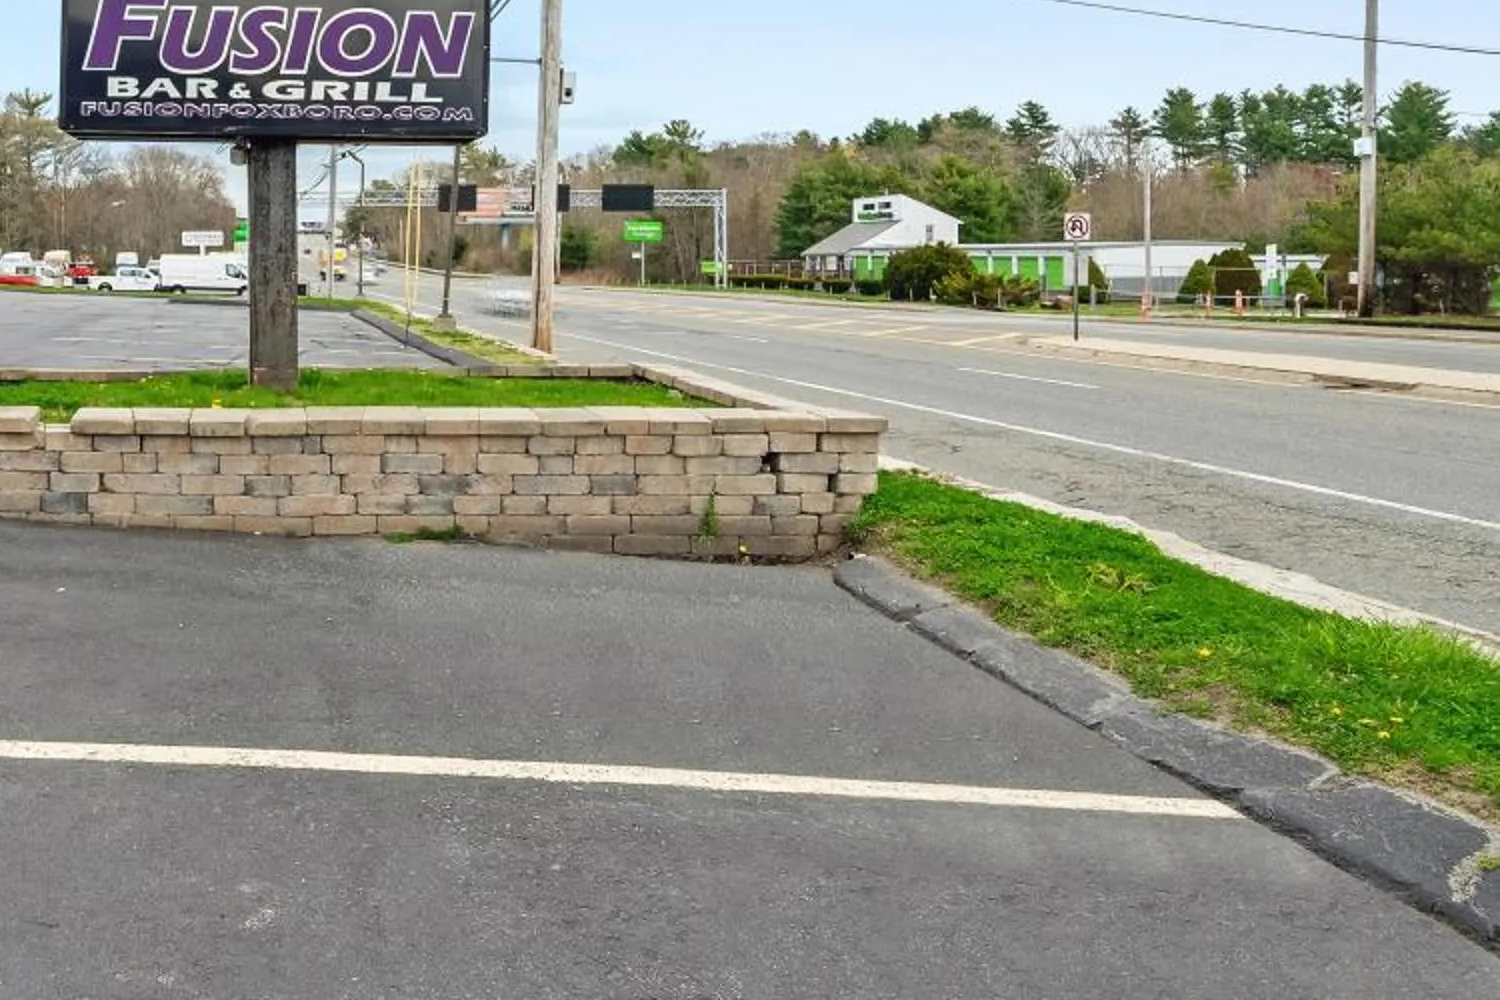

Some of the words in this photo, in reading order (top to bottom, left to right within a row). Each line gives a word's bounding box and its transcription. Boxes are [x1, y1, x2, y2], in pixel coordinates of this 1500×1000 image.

[106, 76, 219, 99] BAR
[227, 83, 252, 100] &
[261, 78, 444, 103] GRILL
[79, 101, 475, 122] FUSIONFOXBORO.COM
